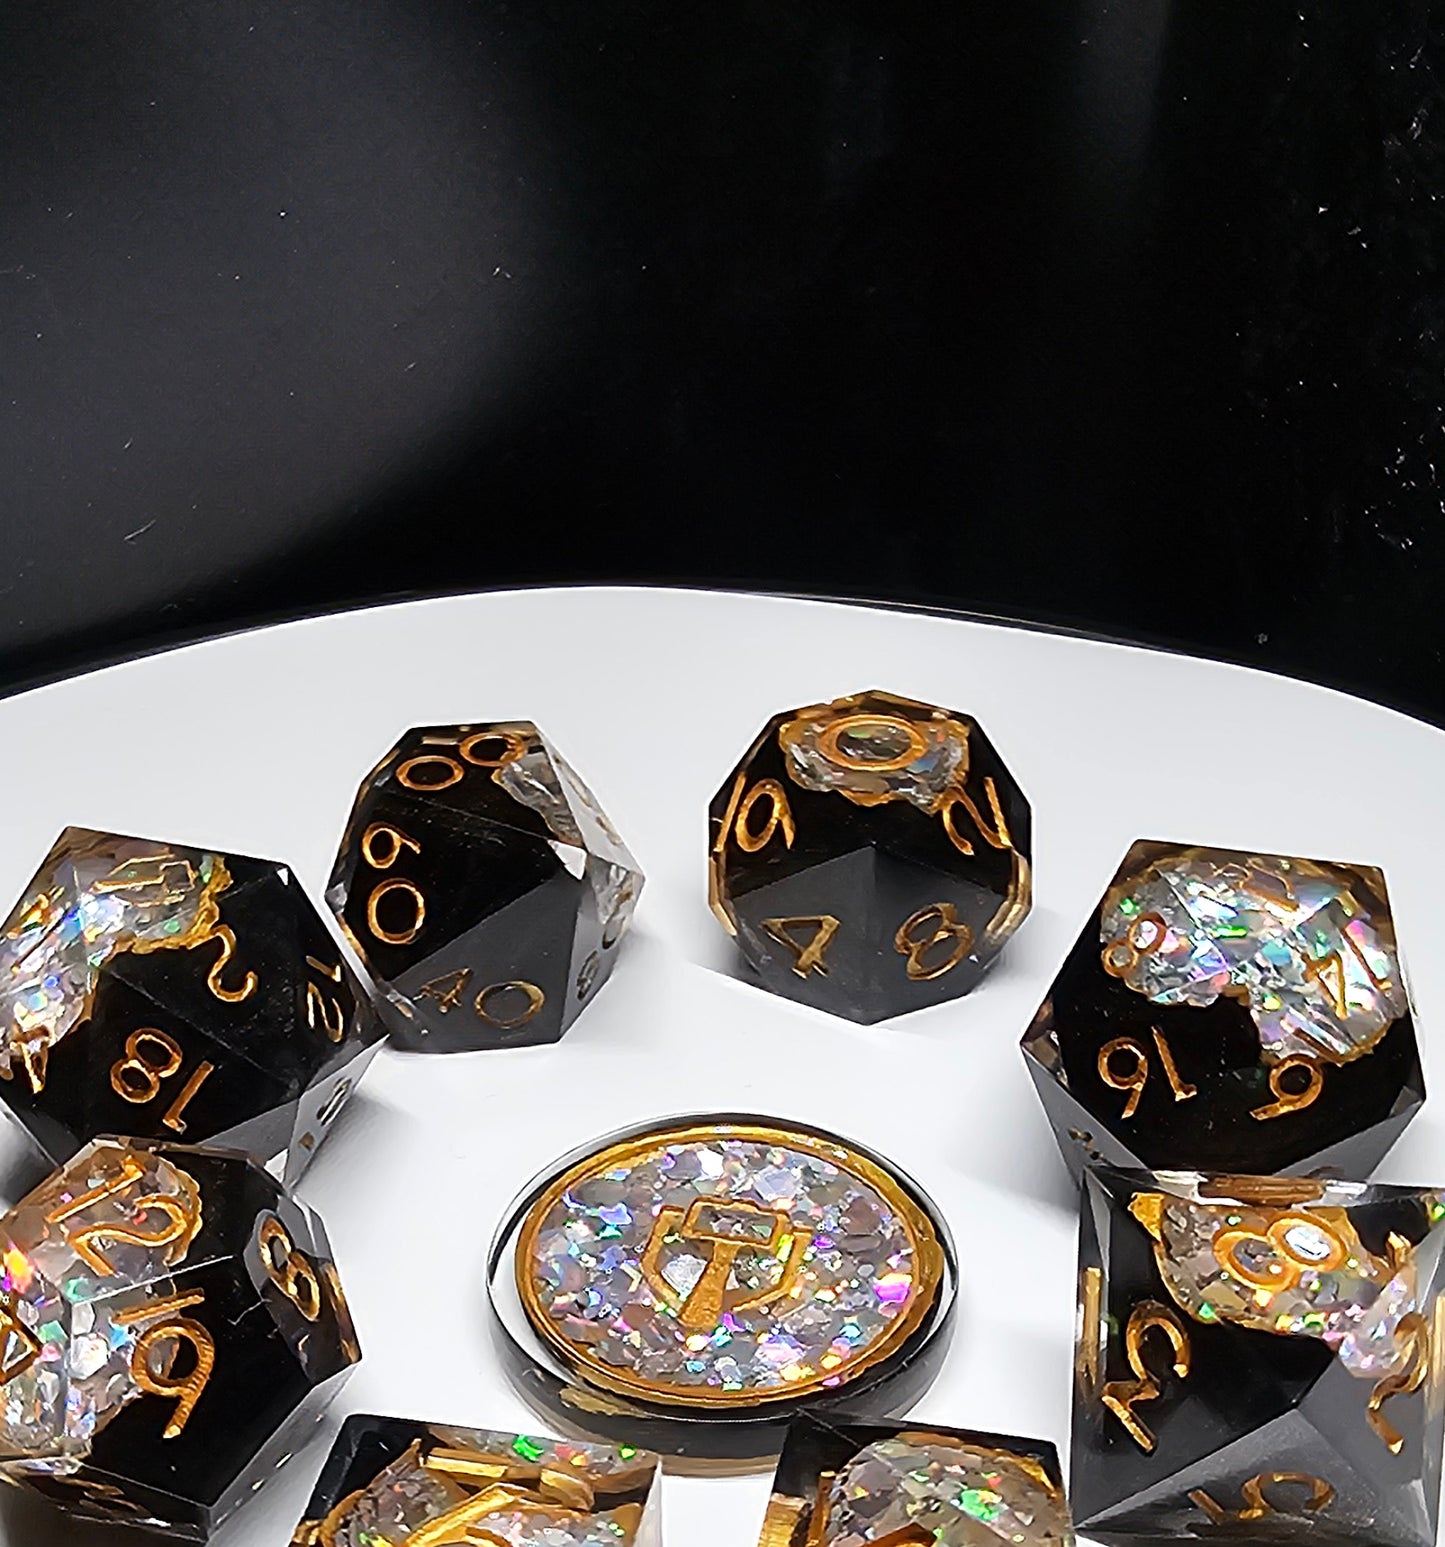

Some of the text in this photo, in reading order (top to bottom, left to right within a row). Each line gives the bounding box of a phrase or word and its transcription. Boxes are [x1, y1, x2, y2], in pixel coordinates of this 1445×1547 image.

[818, 712, 930, 771] 0
[761, 914, 841, 980] 4
[894, 901, 976, 981] 8
[46, 1155, 191, 1276] 12
[1212, 1212, 1347, 1292] 8
[258, 1216, 321, 1322] 8
